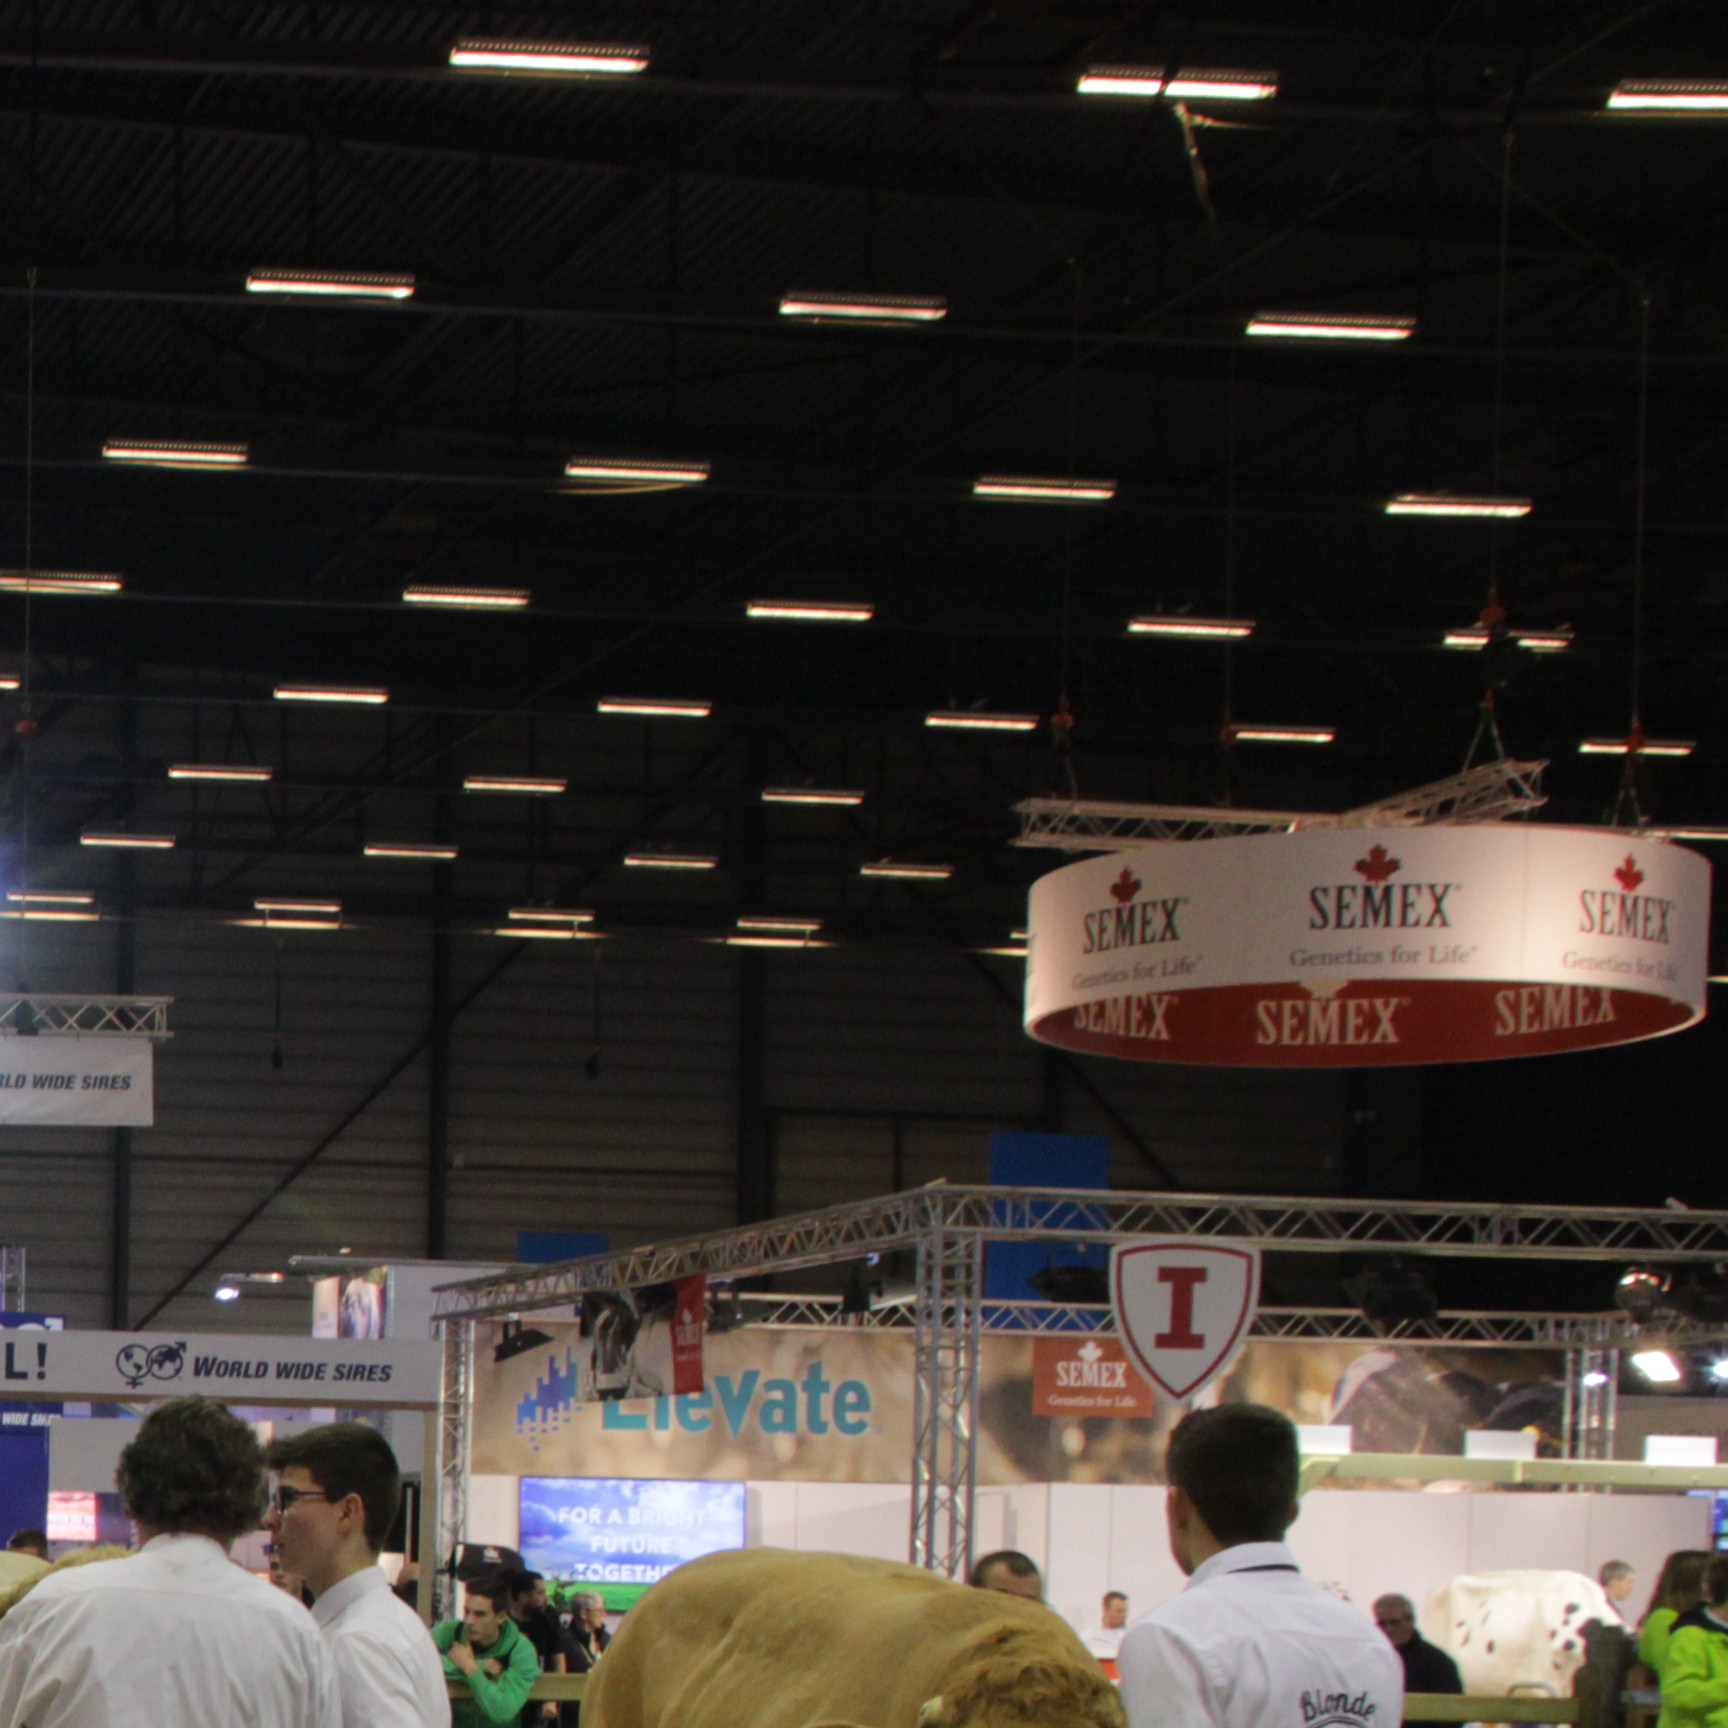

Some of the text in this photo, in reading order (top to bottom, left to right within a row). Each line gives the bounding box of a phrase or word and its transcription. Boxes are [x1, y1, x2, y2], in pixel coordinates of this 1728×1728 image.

[1309, 884, 1452, 929] SEMEX
[1579, 890, 1672, 944] SEMEX
[1083, 898, 1182, 954] SEMEX
[1133, 960, 1156, 980] for
[1290, 947, 1384, 967] Genetics
[1391, 945, 1422, 964] for
[1562, 951, 1633, 974] Genetics
[1074, 993, 1170, 1040] SEMEX
[1256, 998, 1400, 1045] SEMEX
[1494, 986, 1617, 1036] SEMEX
[1154, 1265, 1208, 1350] I
[1056, 1361, 1127, 1388] SEMEX
[558, 1506, 707, 1527] FOR A BRIGHT
[591, 1536, 674, 1553] FUTURE
[1300, 1689, 1376, 1721] Blonde
